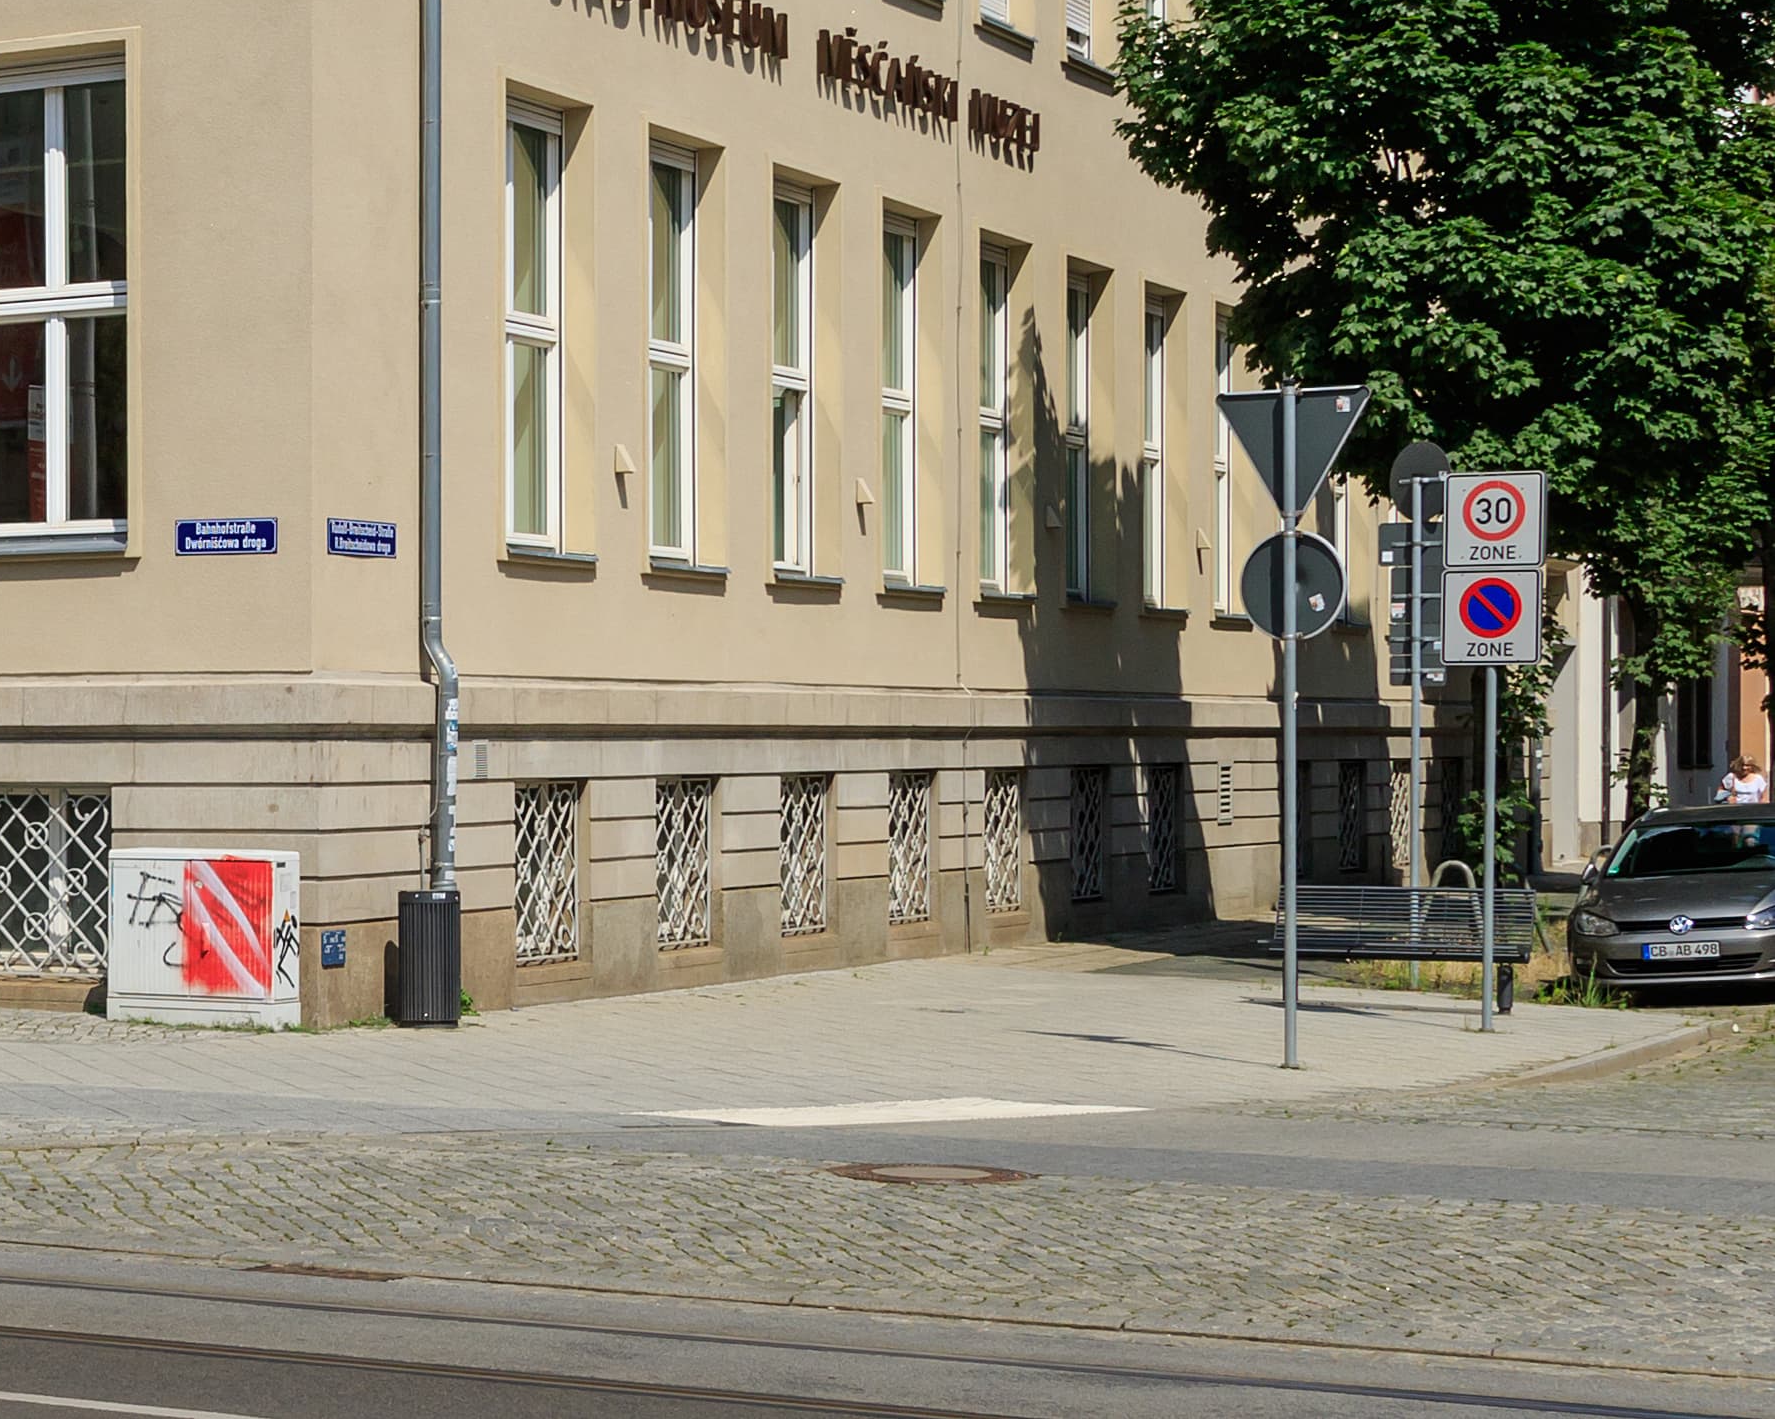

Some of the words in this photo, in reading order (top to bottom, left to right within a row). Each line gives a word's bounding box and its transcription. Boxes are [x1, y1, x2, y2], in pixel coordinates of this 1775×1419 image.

[1476, 497, 1511, 524] 30
[195, 521, 256, 535] Bahnhofstraße
[242, 535, 267, 551] droga
[1469, 545, 1517, 561] ZONE
[1466, 642, 1514, 658] ZONE
[1650, 946, 1667, 957] CB
[1675, 945, 1692, 956] AB
[1694, 943, 1718, 955] 498
